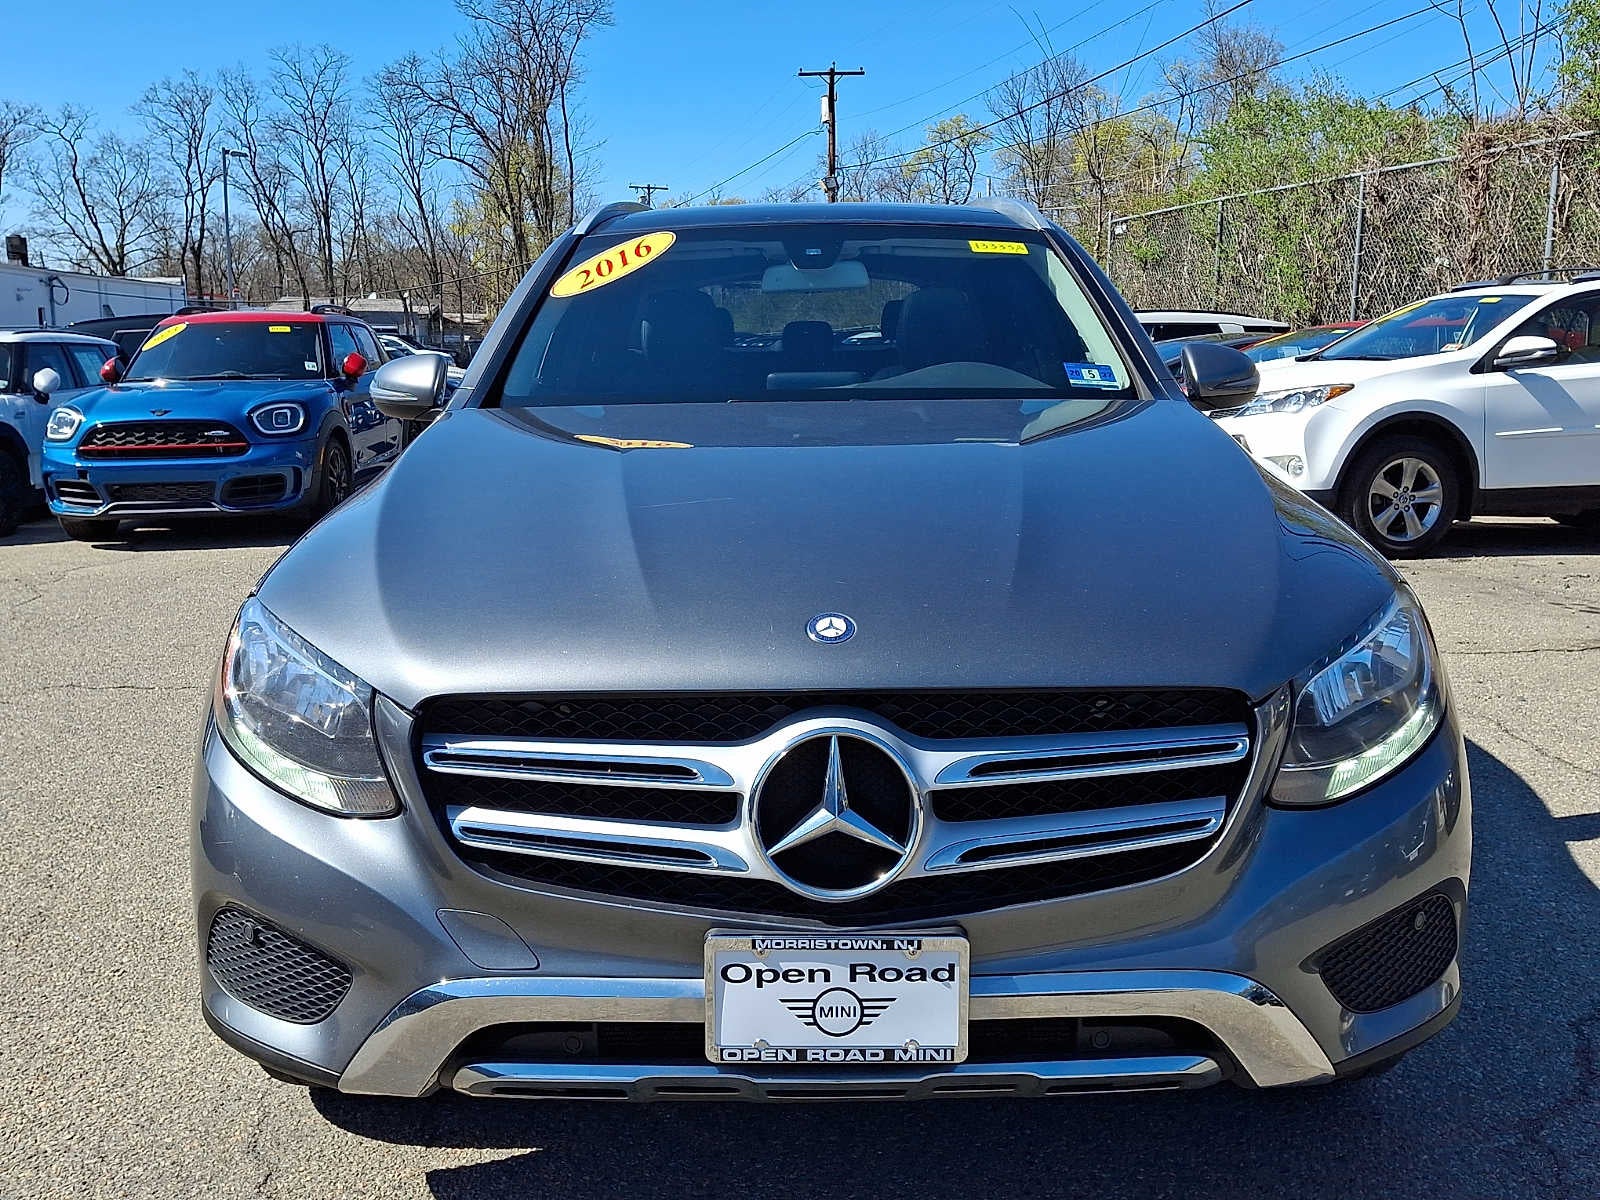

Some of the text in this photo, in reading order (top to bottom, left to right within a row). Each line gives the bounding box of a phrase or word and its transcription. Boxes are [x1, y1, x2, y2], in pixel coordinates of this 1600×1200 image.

[576, 239, 652, 289] 2016
[1087, 369, 1096, 379] 5
[894, 939, 919, 950] NJ
[720, 962, 956, 988] Open Road
[819, 1006, 857, 1019] MINI
[722, 1048, 952, 1062] OPEN ROAD MINI
